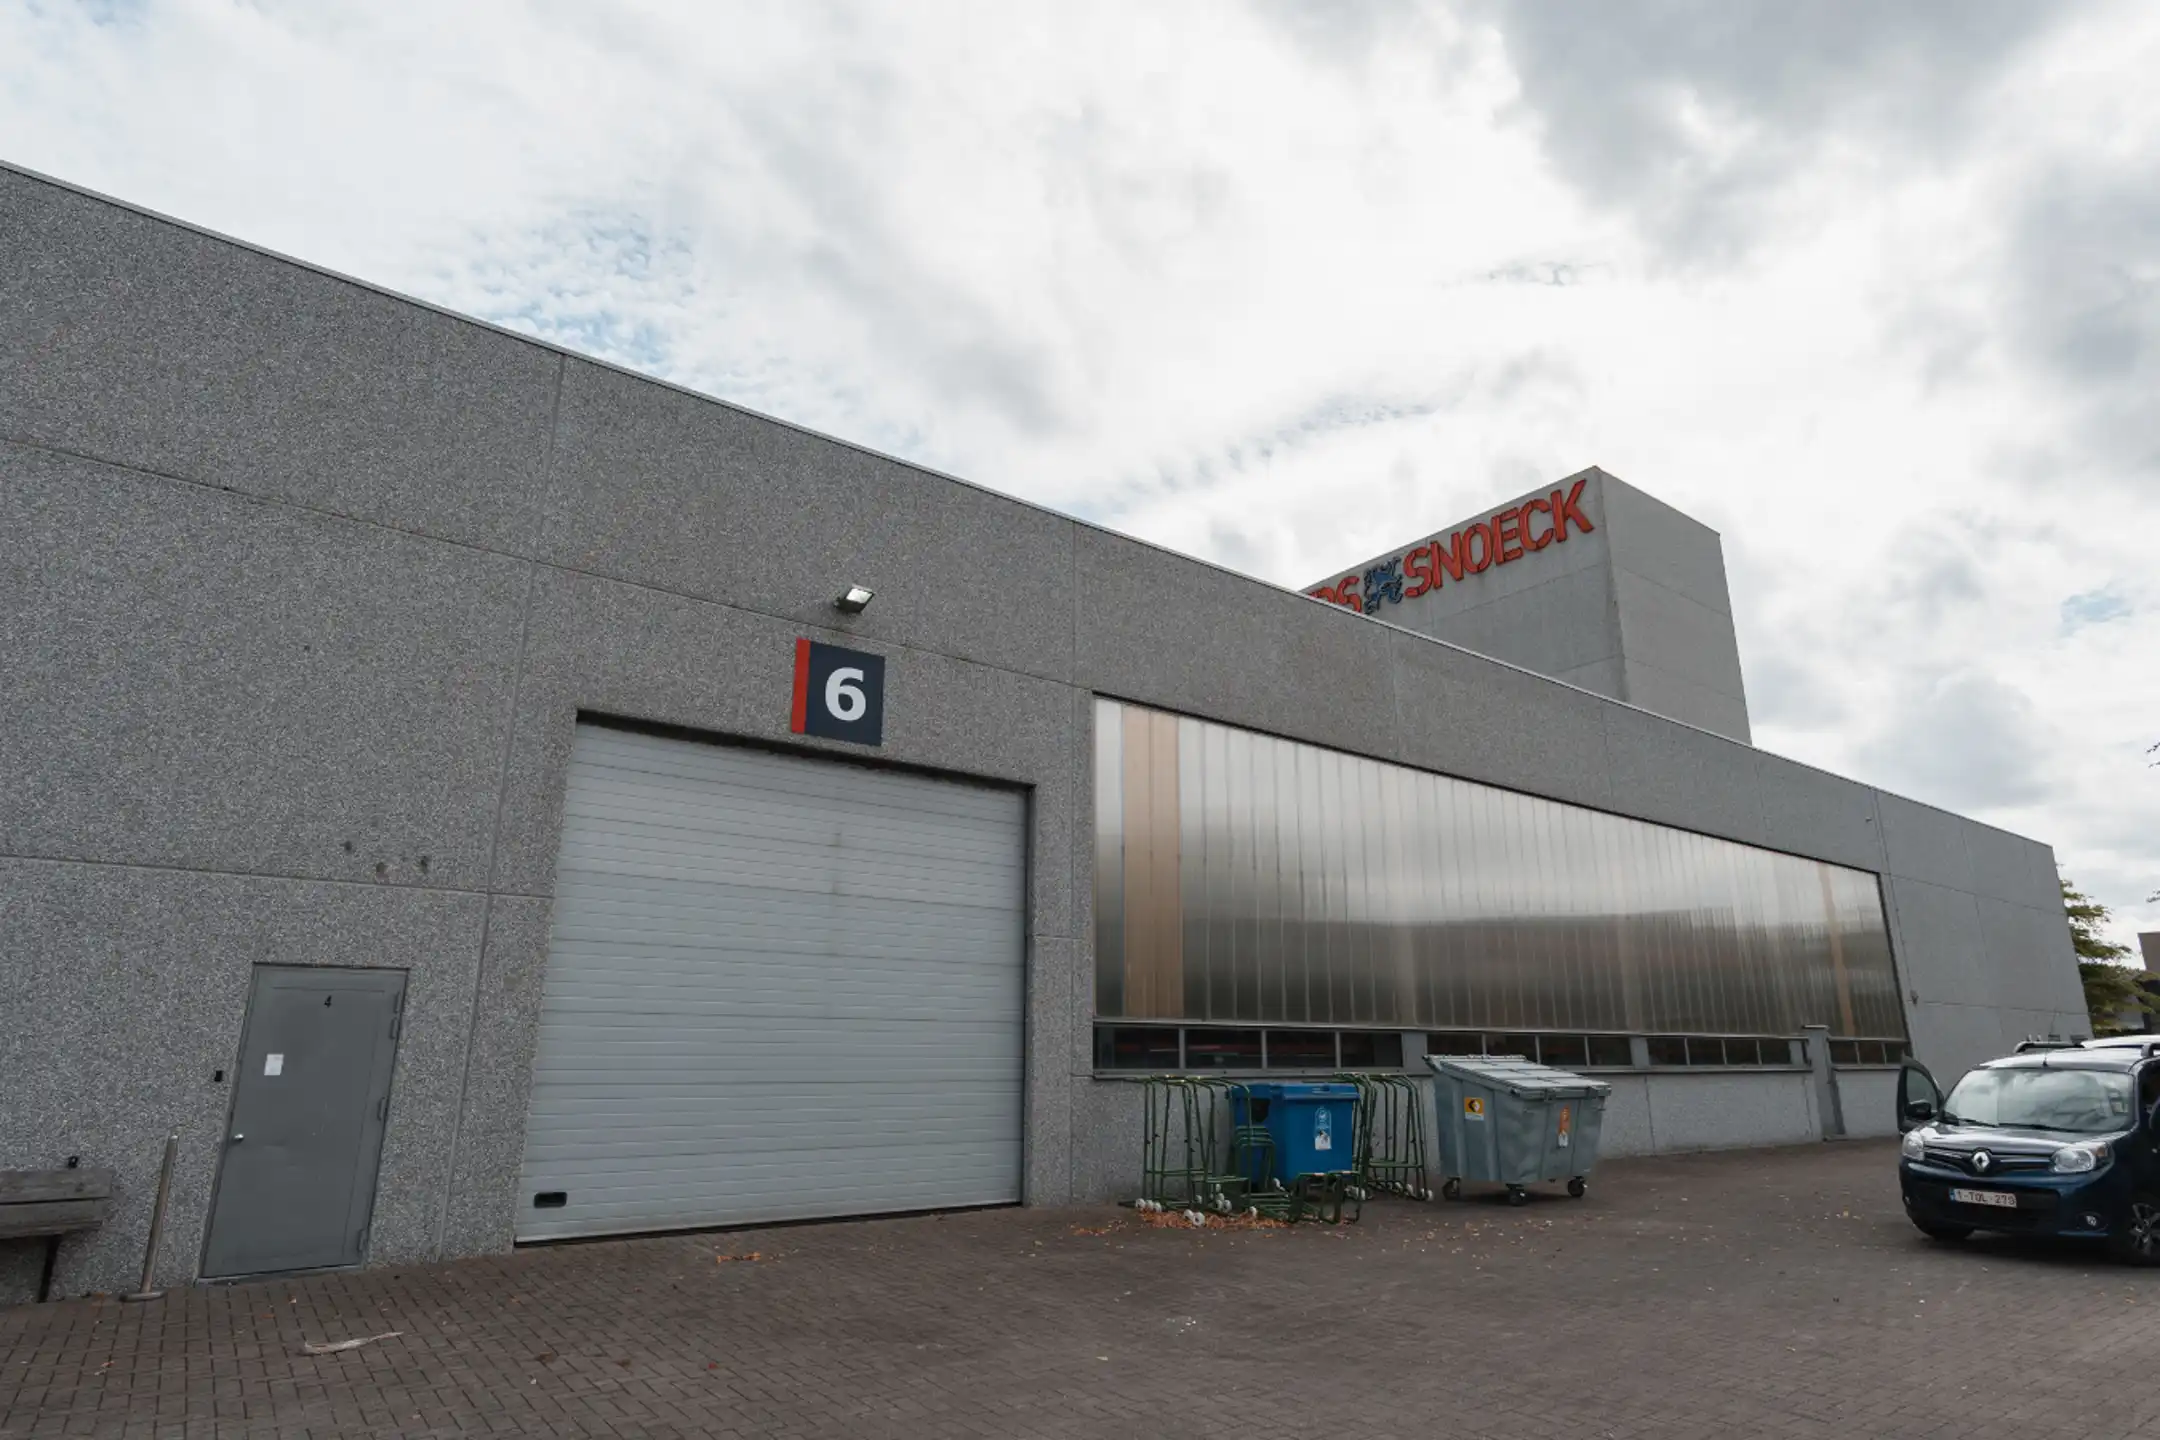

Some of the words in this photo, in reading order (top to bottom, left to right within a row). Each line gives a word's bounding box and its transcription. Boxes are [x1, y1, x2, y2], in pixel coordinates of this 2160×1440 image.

[1403, 479, 1594, 598] SNOECK
[825, 667, 866, 722] 6
[323, 994, 333, 1009] 4
